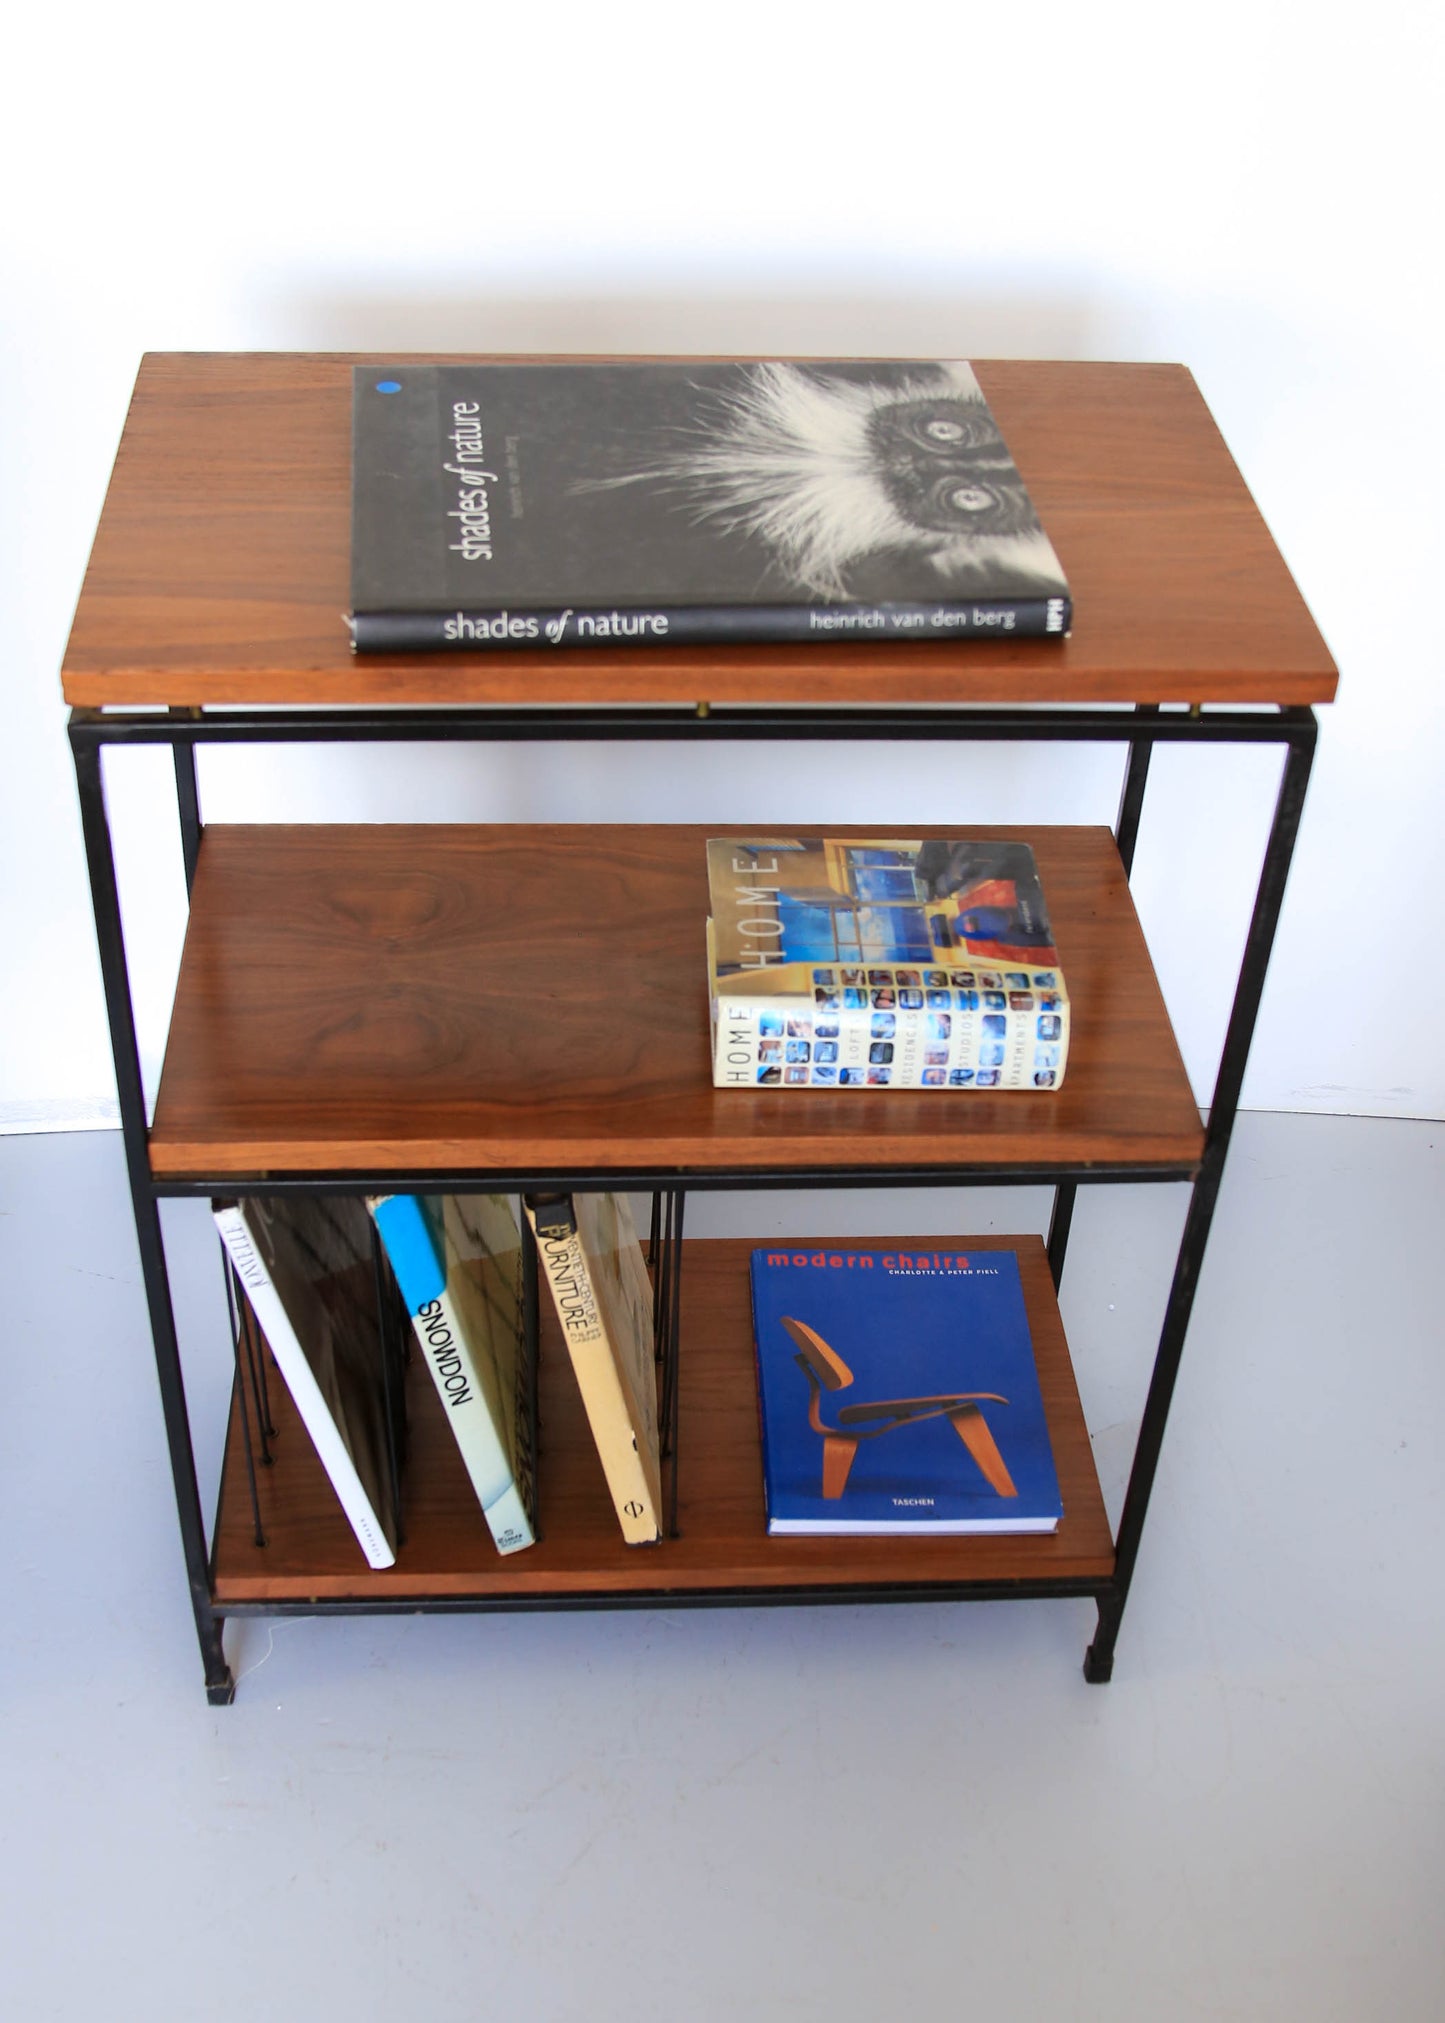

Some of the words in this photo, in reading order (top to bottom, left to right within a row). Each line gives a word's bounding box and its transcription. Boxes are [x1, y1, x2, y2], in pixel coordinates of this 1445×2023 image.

[448, 401, 485, 463] nature
[443, 462, 498, 486] of
[447, 487, 493, 561] shades
[443, 611, 539, 640] shades
[545, 608, 573, 644] of
[577, 611, 669, 637] nature
[810, 609, 885, 630] heinrich
[892, 611, 925, 629] van
[931, 608, 966, 628] den
[972, 607, 1016, 631] berg
[732, 856, 788, 969] HOME
[726, 1005, 753, 1083] HOME
[957, 1013, 973, 1068] STUDIOS
[540, 1224, 588, 1331] FURNITURE
[767, 1253, 874, 1268] modern
[882, 1253, 970, 1269] chairs
[418, 1299, 473, 1407] SNOWDON
[892, 1498, 935, 1507] TASCHEN
